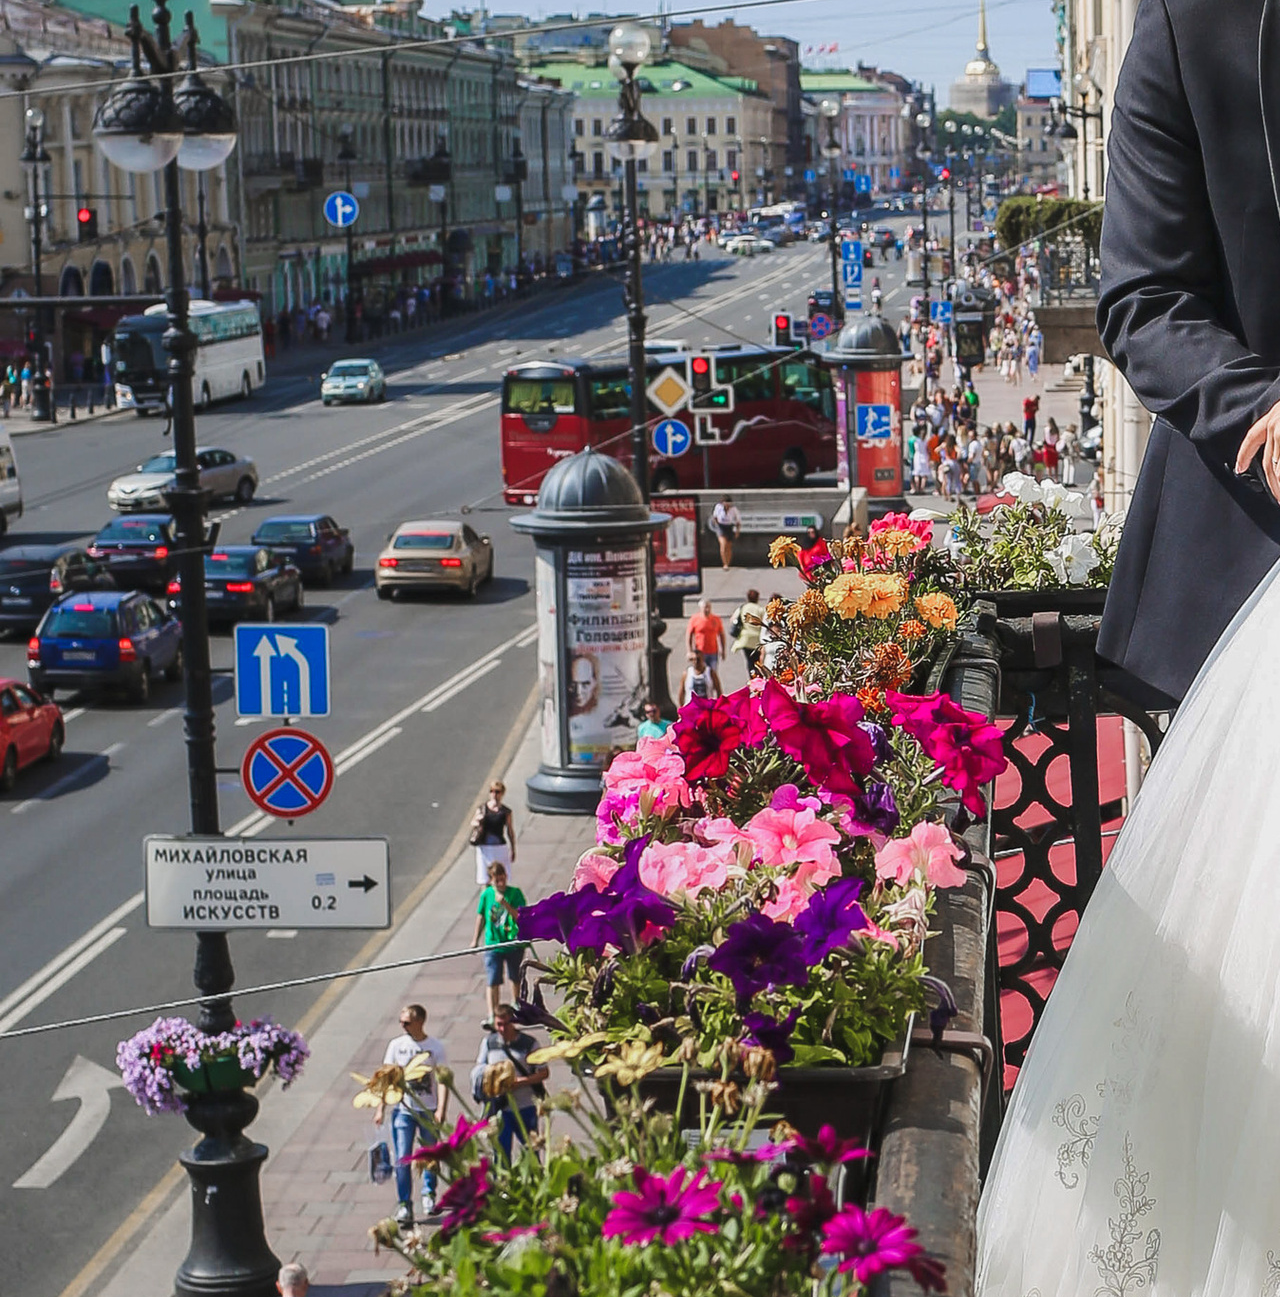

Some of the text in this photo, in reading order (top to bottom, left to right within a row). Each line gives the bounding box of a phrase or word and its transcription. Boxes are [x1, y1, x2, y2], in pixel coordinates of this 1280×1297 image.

[154, 846, 308, 864] МИХАЙЛОВСКАЯ
[205, 868, 257, 883] улица
[193, 888, 269, 902] площадь
[311, 894, 337, 910] 0.2
[183, 905, 280, 919] ИСКУССТВ
